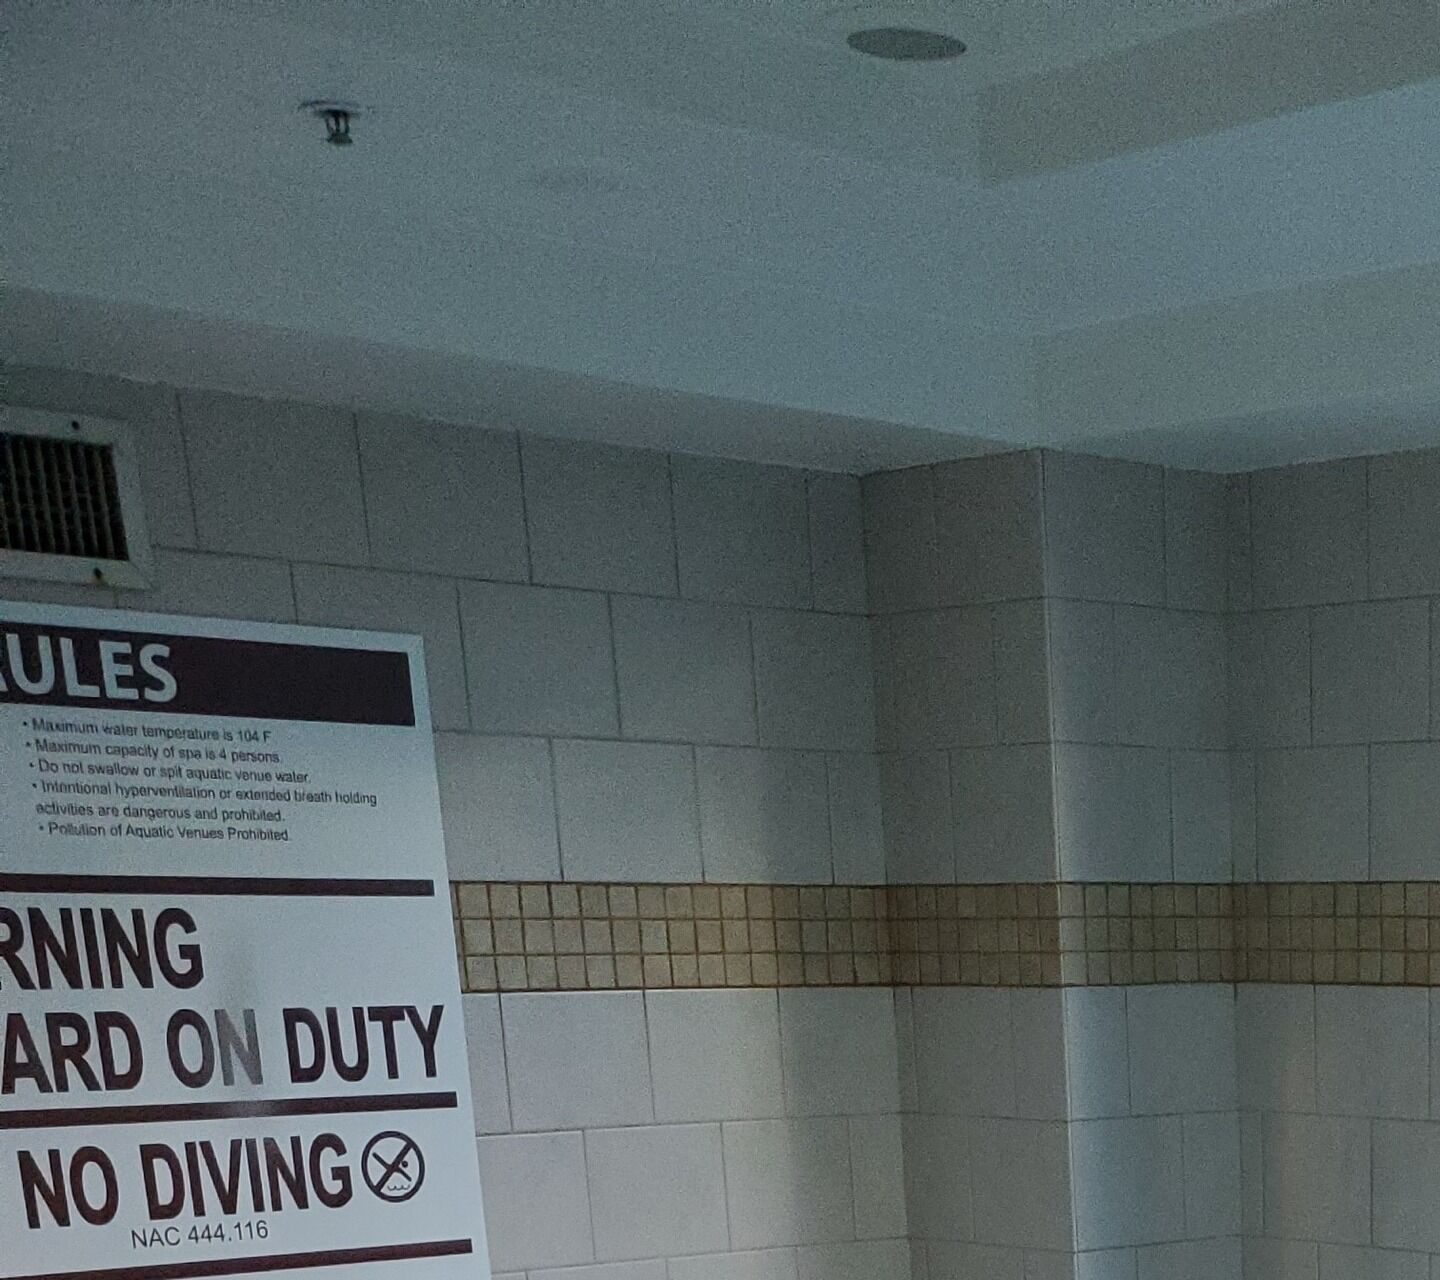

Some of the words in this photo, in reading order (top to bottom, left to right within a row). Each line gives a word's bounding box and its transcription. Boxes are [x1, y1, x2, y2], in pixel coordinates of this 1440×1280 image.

[0, 633, 178, 703] ULES
[32, 717, 98, 734] Maximum
[103, 721, 138, 737] water
[142, 723, 219, 741] temperature
[223, 730, 233, 742] is
[239, 730, 258, 743] 104
[263, 731, 272, 743] F
[35, 738, 100, 755] Maximum
[105, 743, 159, 761] capacity
[163, 746, 175, 759] of
[179, 748, 201, 762] spa
[206, 749, 216, 760] is
[219, 749, 226, 761] 4
[38, 758, 58, 773] Do
[63, 760, 84, 774] not
[88, 762, 139, 777] swallow
[144, 766, 156, 777] or
[160, 766, 182, 781] spit
[186, 768, 232, 782] aquatic
[236, 770, 272, 783] venue
[41, 780, 111, 796] Intentional
[115, 782, 216, 801] hyperventilation
[219, 790, 231, 800] or
[235, 789, 291, 802] extended
[294, 790, 332, 804] breath
[335, 792, 378, 807] holding
[36, 802, 94, 816] activities
[98, 805, 119, 818] are
[123, 805, 191, 821] dangerous
[195, 807, 218, 820] and
[48, 821, 106, 837] Pollution
[110, 824, 123, 837] of
[126, 825, 174, 840] Aquatic
[178, 827, 224, 840] Venues
[0, 907, 204, 990] RNING
[1, 1011, 143, 1094] ARD
[166, 1008, 263, 1088] ON
[283, 1005, 444, 1084] DUTY
[17, 1145, 119, 1229] NO
[139, 1132, 353, 1220] DIVING
[131, 1227, 181, 1249] NAC
[188, 1219, 269, 1243] 444.116
